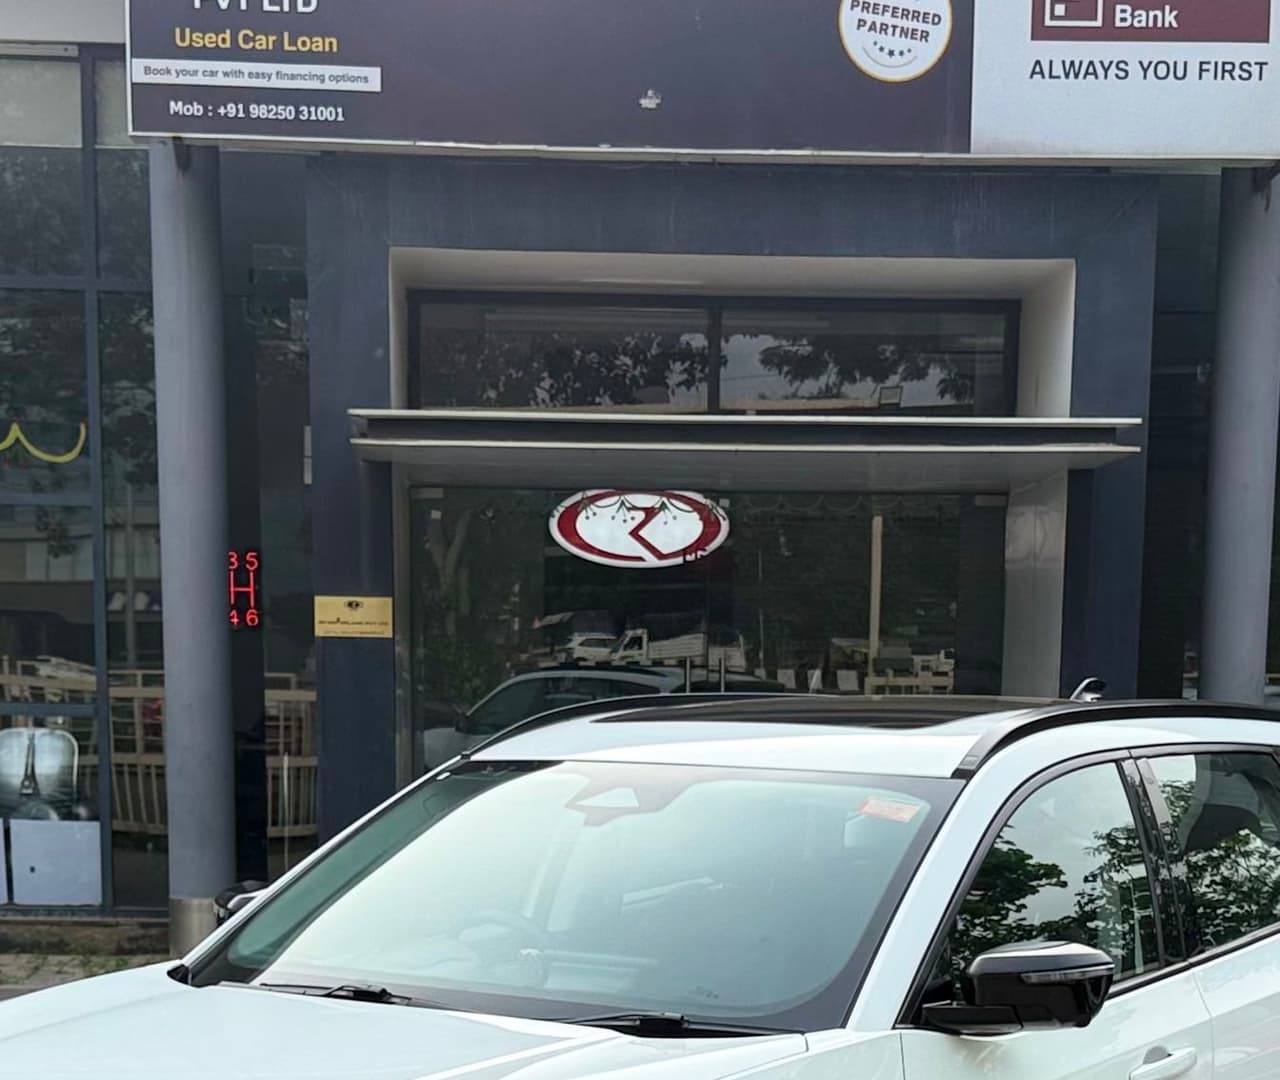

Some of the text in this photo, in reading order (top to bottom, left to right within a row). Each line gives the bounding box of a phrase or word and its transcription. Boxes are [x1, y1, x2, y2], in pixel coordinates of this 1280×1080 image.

[850, 0, 942, 26] PREFERRED
[1114, 5, 1179, 28] Bank
[175, 27, 338, 52] Used Car Loan
[856, 18, 930, 43] PARTNER
[143, 65, 369, 84] Book your car with easy financing options
[1029, 59, 1269, 82] ALWAYS YOU FIRST
[169, 100, 203, 116] Mob
[217, 103, 246, 118] +91
[249, 104, 296, 120] 98250
[299, 105, 345, 122] 31001
